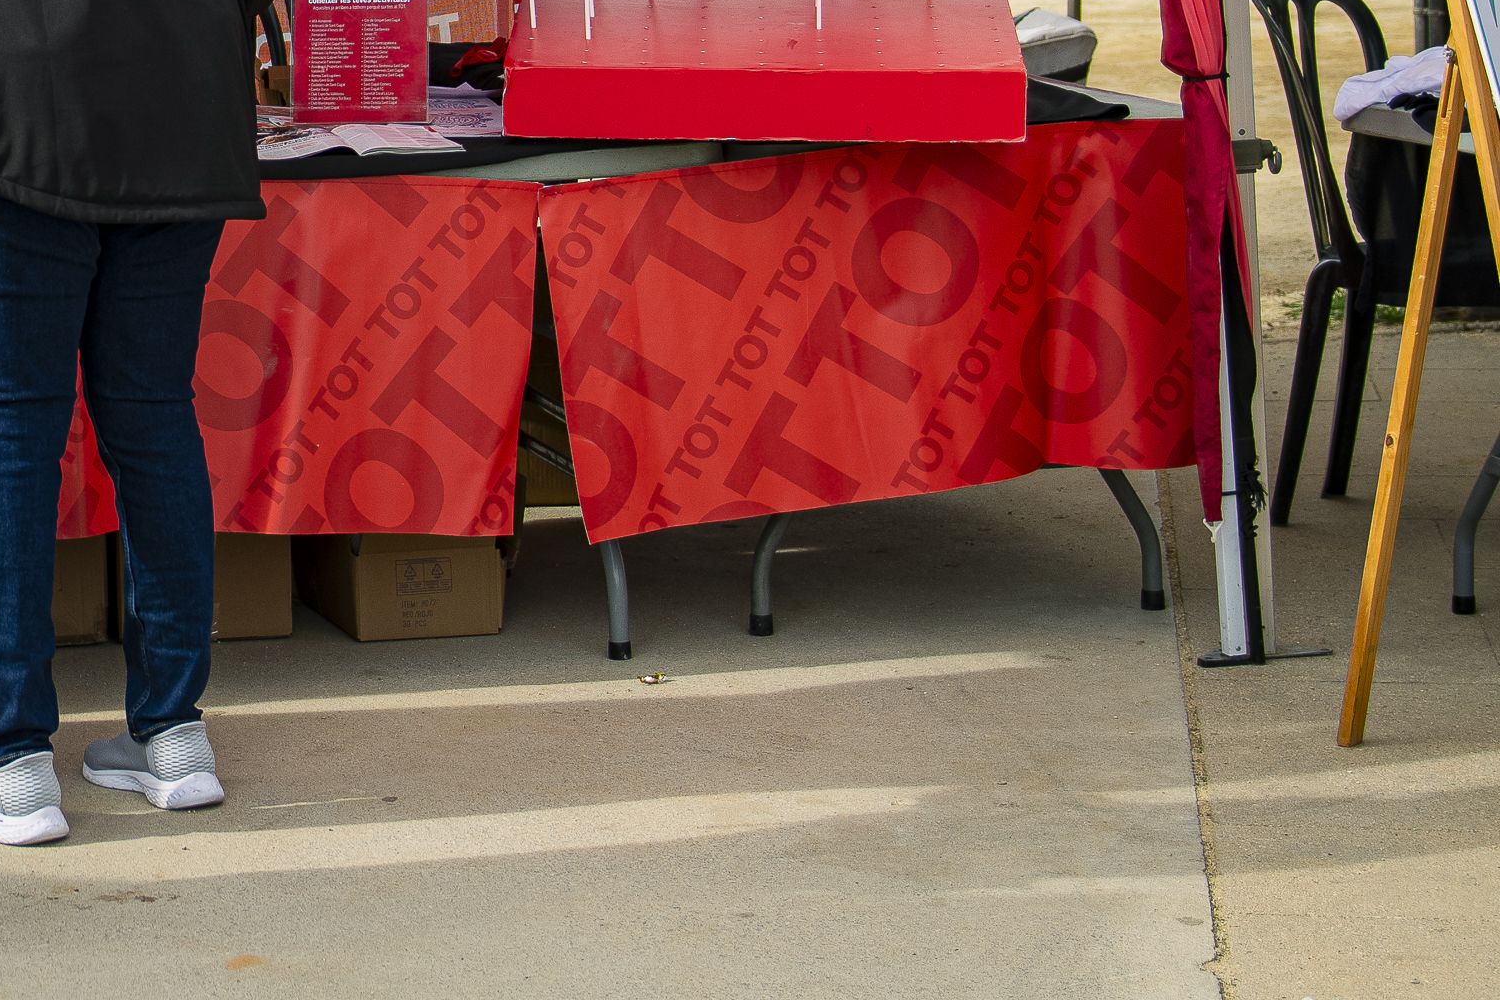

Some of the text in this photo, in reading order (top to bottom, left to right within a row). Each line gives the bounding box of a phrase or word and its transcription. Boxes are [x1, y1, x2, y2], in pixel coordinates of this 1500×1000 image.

[308, 336, 375, 421] TOT
[364, 256, 439, 340] TOT
[664, 395, 732, 479] TOT
[716, 305, 782, 391] TOT
[764, 216, 832, 302] TOT
[891, 408, 955, 492] TOT
[939, 320, 1004, 404] TOT
